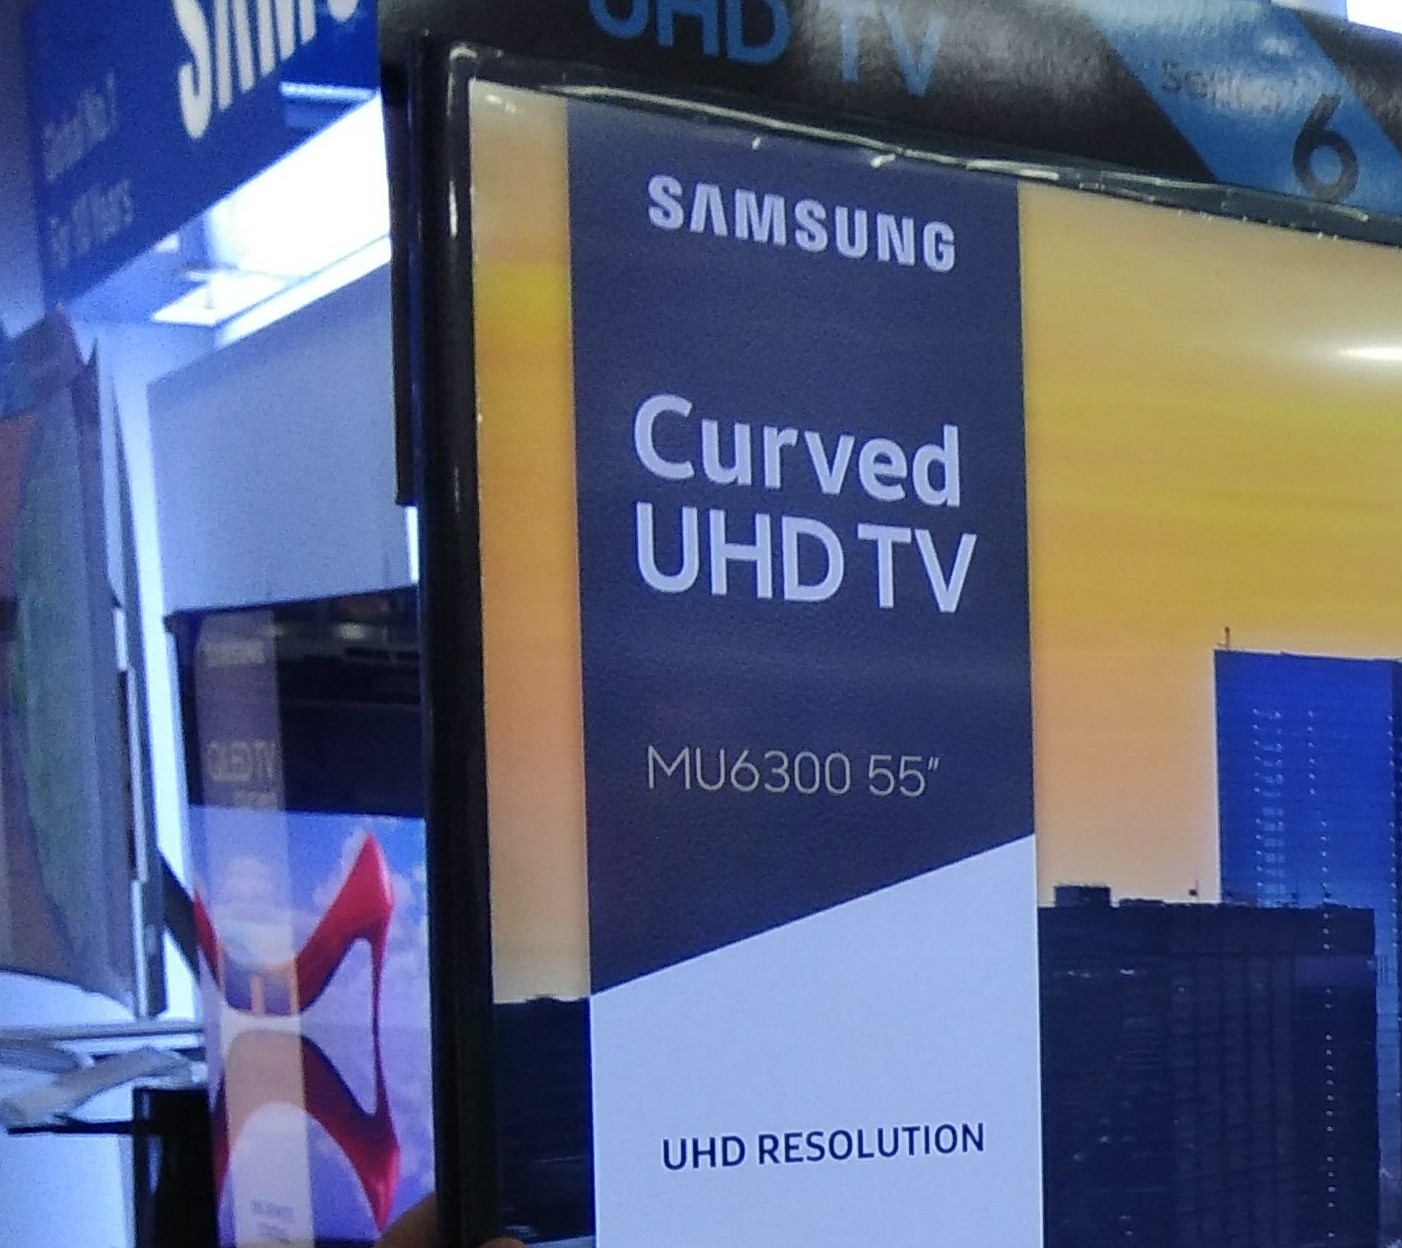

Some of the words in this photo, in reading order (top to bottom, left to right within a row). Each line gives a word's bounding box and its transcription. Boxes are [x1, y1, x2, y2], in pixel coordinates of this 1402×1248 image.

[1293, 91, 1359, 202] 6
[646, 174, 957, 273] SAMSUNG
[633, 393, 961, 508] Curved
[636, 501, 846, 603] UHD
[857, 522, 977, 613] TV
[647, 744, 851, 796] MU6300
[661, 1134, 746, 1171] UHD
[757, 1121, 986, 1165] RESOLUTION
